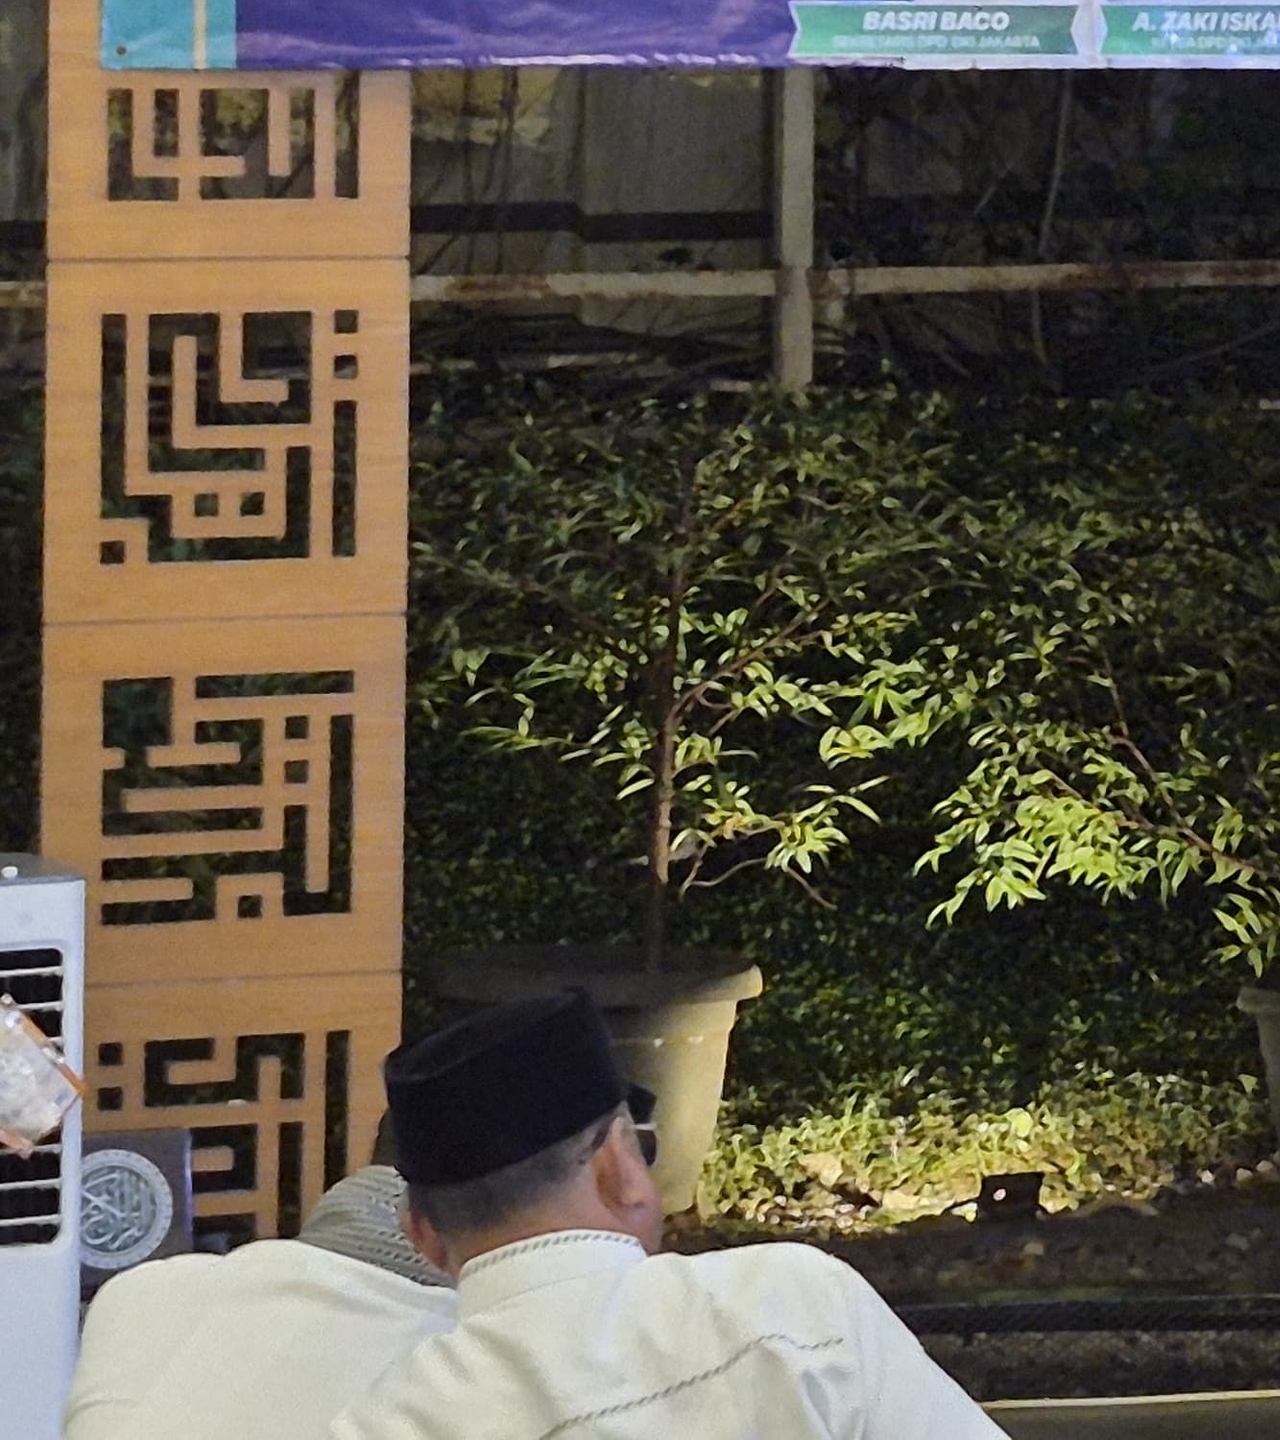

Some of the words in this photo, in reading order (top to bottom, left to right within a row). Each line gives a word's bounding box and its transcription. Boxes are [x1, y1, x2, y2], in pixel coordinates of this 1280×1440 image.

[863, 10, 938, 32] BASRI
[940, 11, 1011, 32] BACO
[1132, 11, 1156, 32] A.
[1160, 11, 1219, 32] ZAKI
